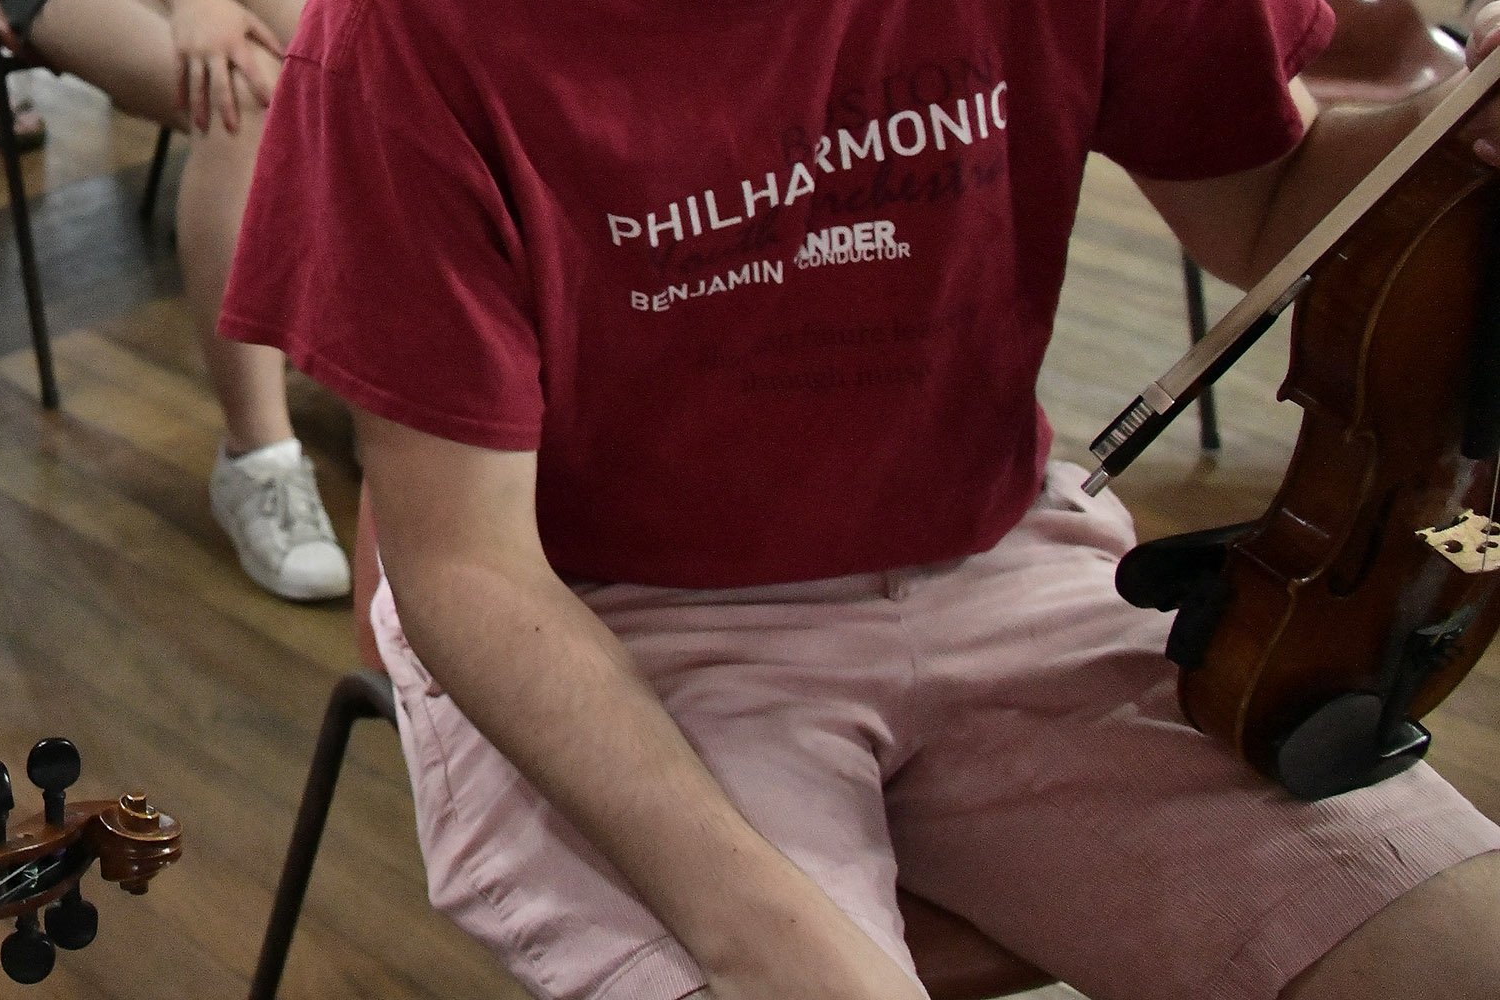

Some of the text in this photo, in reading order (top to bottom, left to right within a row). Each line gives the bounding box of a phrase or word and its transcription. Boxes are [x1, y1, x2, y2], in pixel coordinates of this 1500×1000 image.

[781, 58, 994, 165] BSTON
[606, 80, 1008, 248] PHILHARMONIC
[631, 260, 784, 312] BENJAMIN
[796, 242, 911, 270] CONDUCTOR
